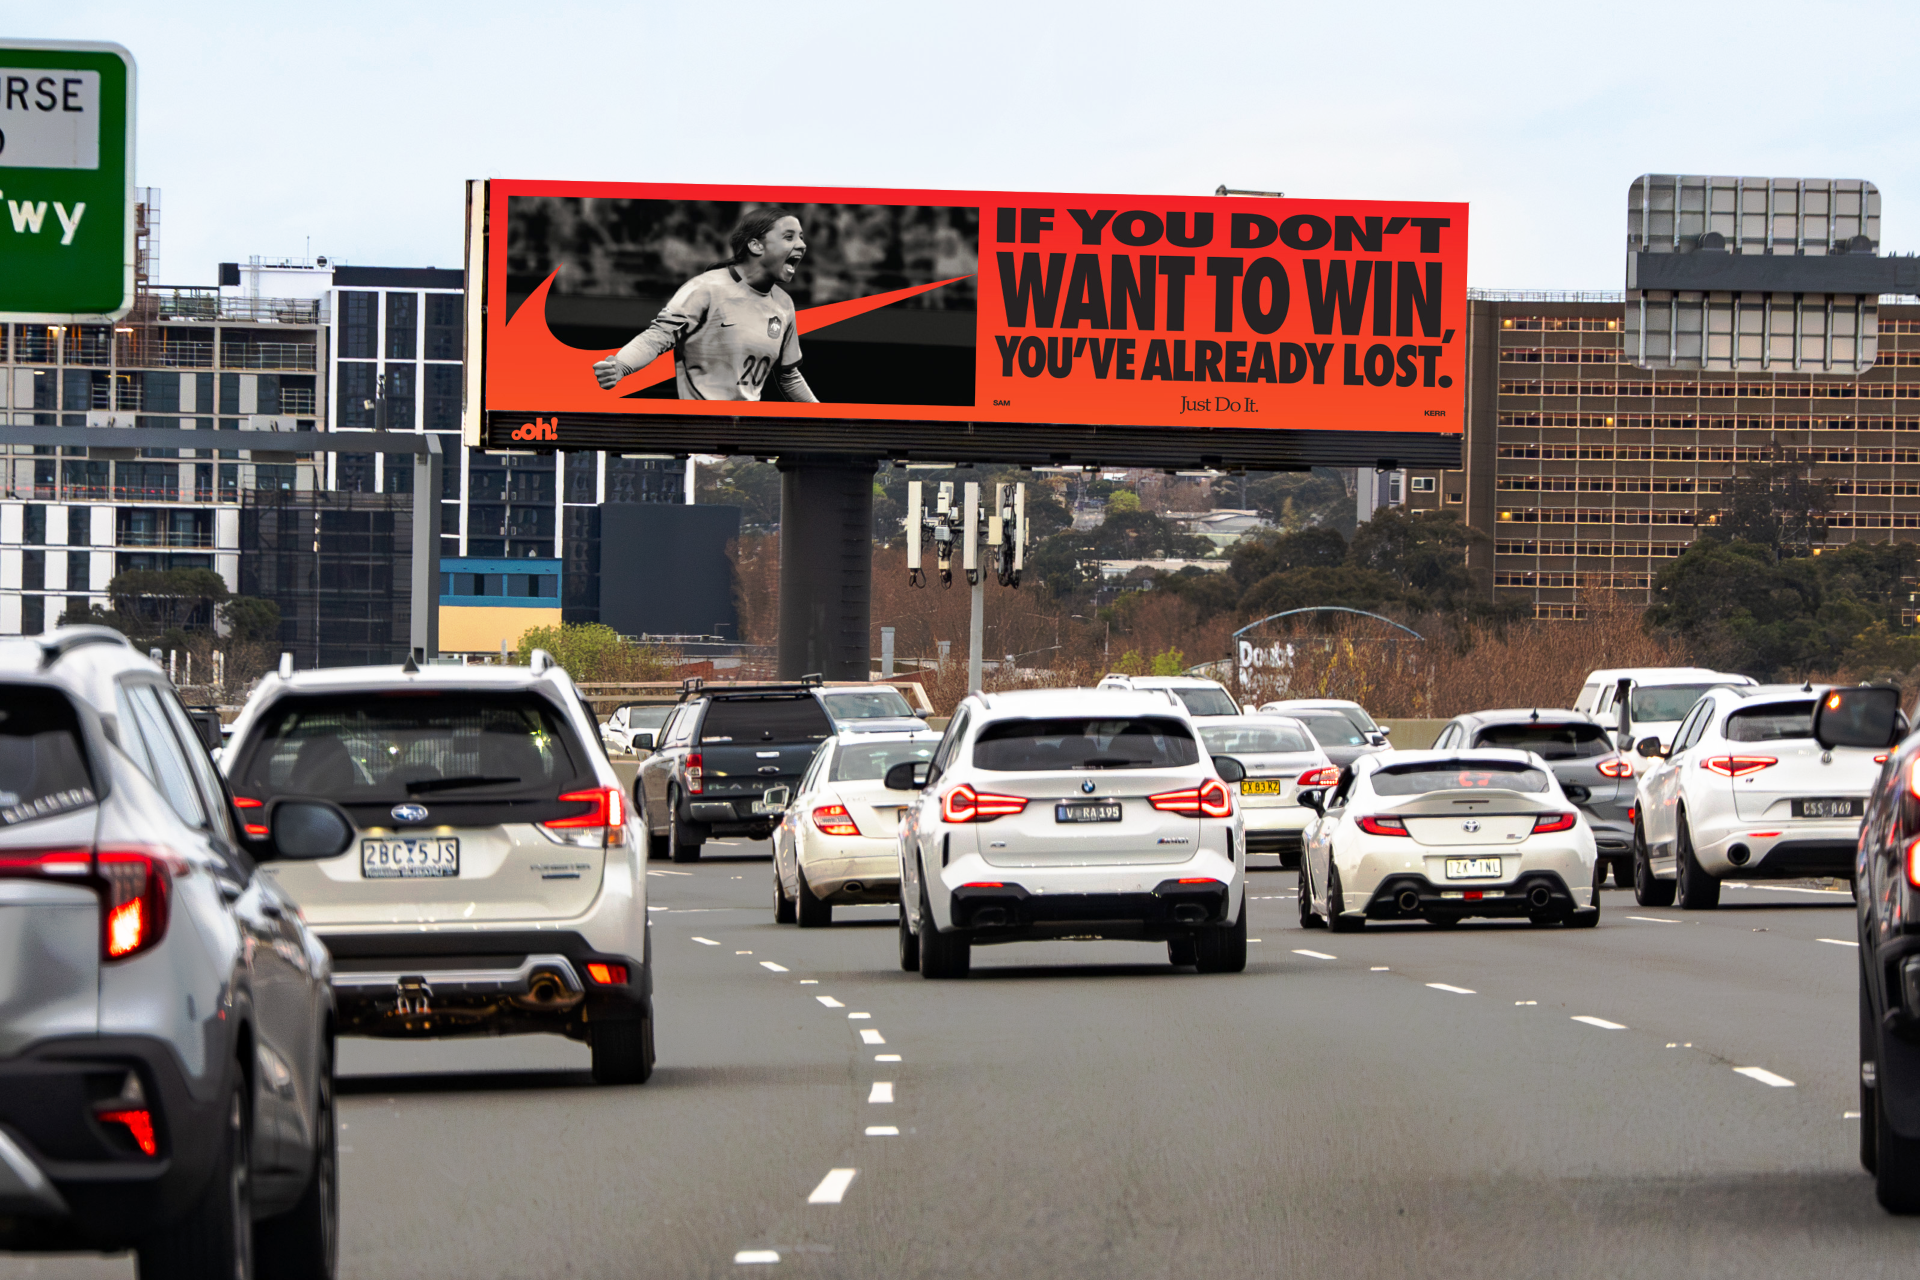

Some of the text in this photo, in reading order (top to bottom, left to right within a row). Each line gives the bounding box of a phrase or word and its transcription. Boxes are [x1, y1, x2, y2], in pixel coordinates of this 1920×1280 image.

[0, 76, 83, 112] RSE
[0, 189, 86, 246] wy
[997, 207, 1451, 254] IF YOU DON'T
[996, 252, 1456, 344] WANT TO WIN,
[736, 355, 771, 387] 20
[995, 335, 1453, 389] YOU'VE ALREADY LOST.
[993, 399, 1011, 407] SAM
[1180, 396, 1259, 415] Just Do It.
